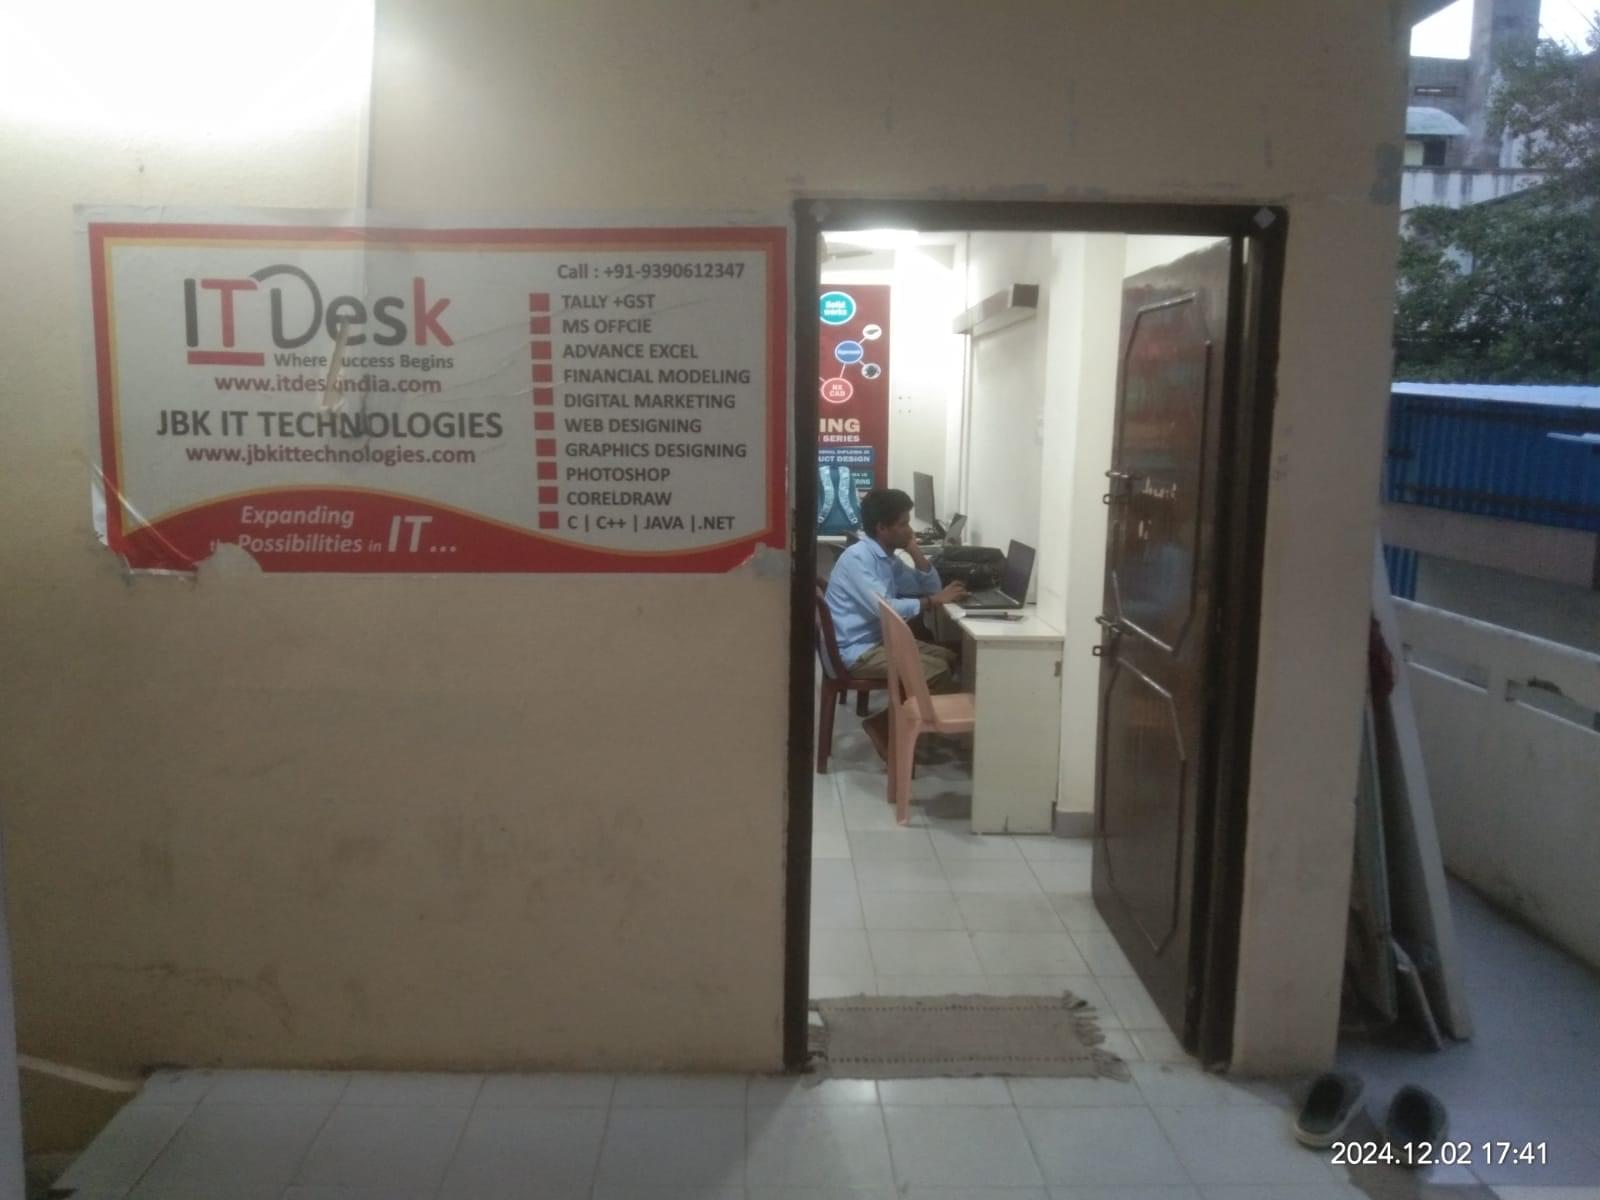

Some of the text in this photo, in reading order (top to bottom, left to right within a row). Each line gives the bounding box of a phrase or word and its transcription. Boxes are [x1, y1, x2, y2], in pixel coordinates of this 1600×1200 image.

[557, 263, 589, 280] Call
[603, 262, 745, 280] +91-9390612347
[183, 263, 455, 350] IT Desk
[561, 293, 656, 310] TALLY +GST
[562, 319, 653, 335] MS OFFCIE
[562, 344, 698, 359] ADVANCE EXCEL
[273, 352, 454, 372] Where uccess Begins
[214, 375, 443, 393] www.itdesindia.com
[563, 368, 751, 384] FINANCIAL MODELING
[564, 393, 736, 409] DIGITAL MARKETING
[156, 409, 504, 440] JBK IT TECHNOLOGIES
[564, 418, 702, 433] WEB DESIGNING
[185, 444, 476, 467] www.jbkittechnologies.com
[565, 443, 748, 458] GRAPHICS DESIGNING
[566, 467, 671, 482] PHOTOSHOP
[566, 491, 673, 506] CORELDRAW
[240, 504, 355, 530] Expanding
[567, 515, 578, 530] C
[596, 515, 627, 530] C++
[643, 515, 685, 531] JAVA
[238, 533, 364, 555] Possibilities
[367, 539, 383, 554] in
